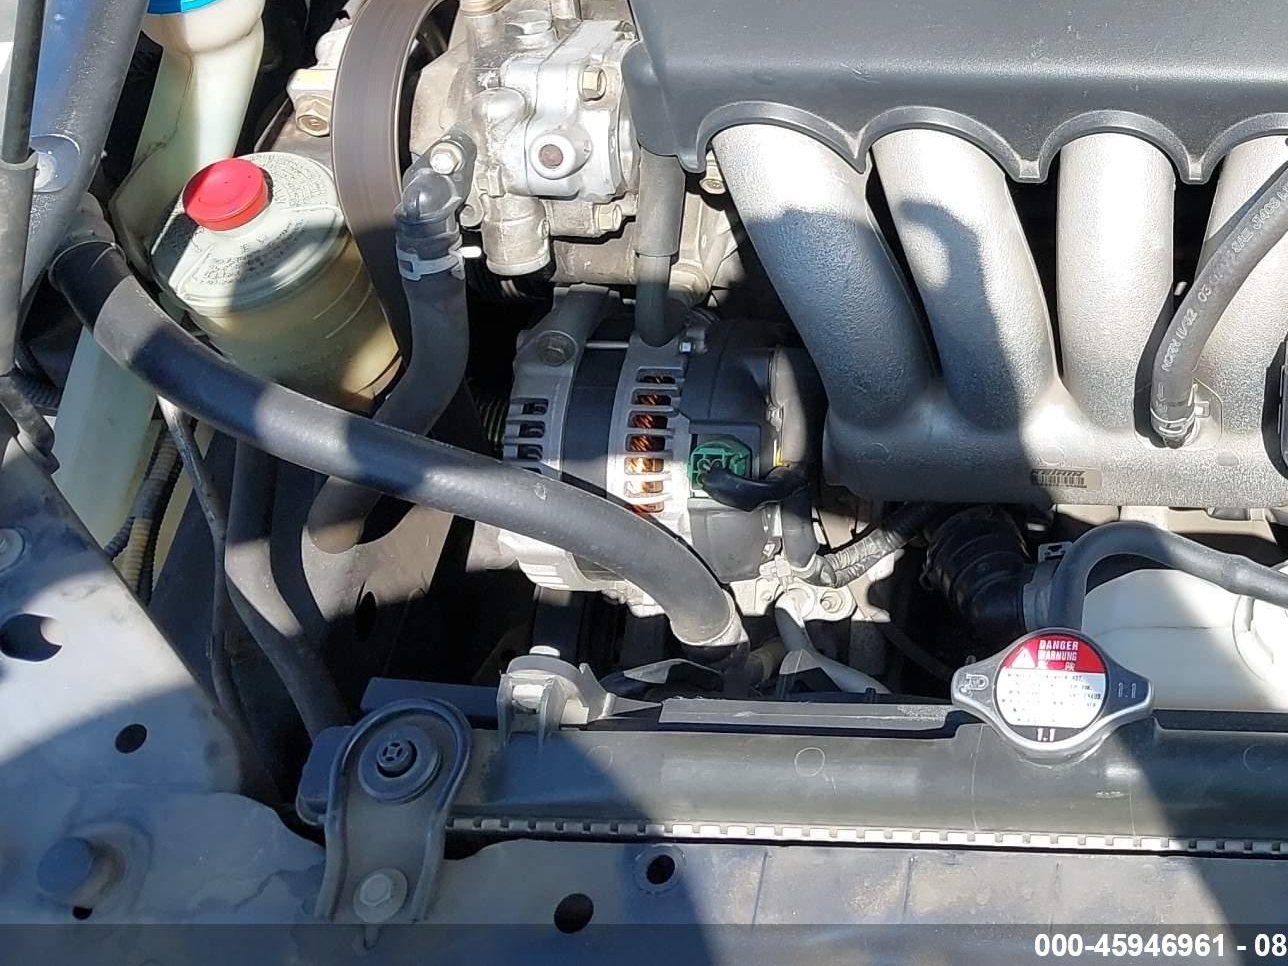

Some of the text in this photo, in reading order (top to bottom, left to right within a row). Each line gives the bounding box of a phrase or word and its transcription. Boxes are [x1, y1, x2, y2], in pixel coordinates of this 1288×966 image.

[1038, 640, 1079, 650] DANGER
[1037, 650, 1078, 661] WARNUNG
[1036, 727, 1056, 742] 1.1
